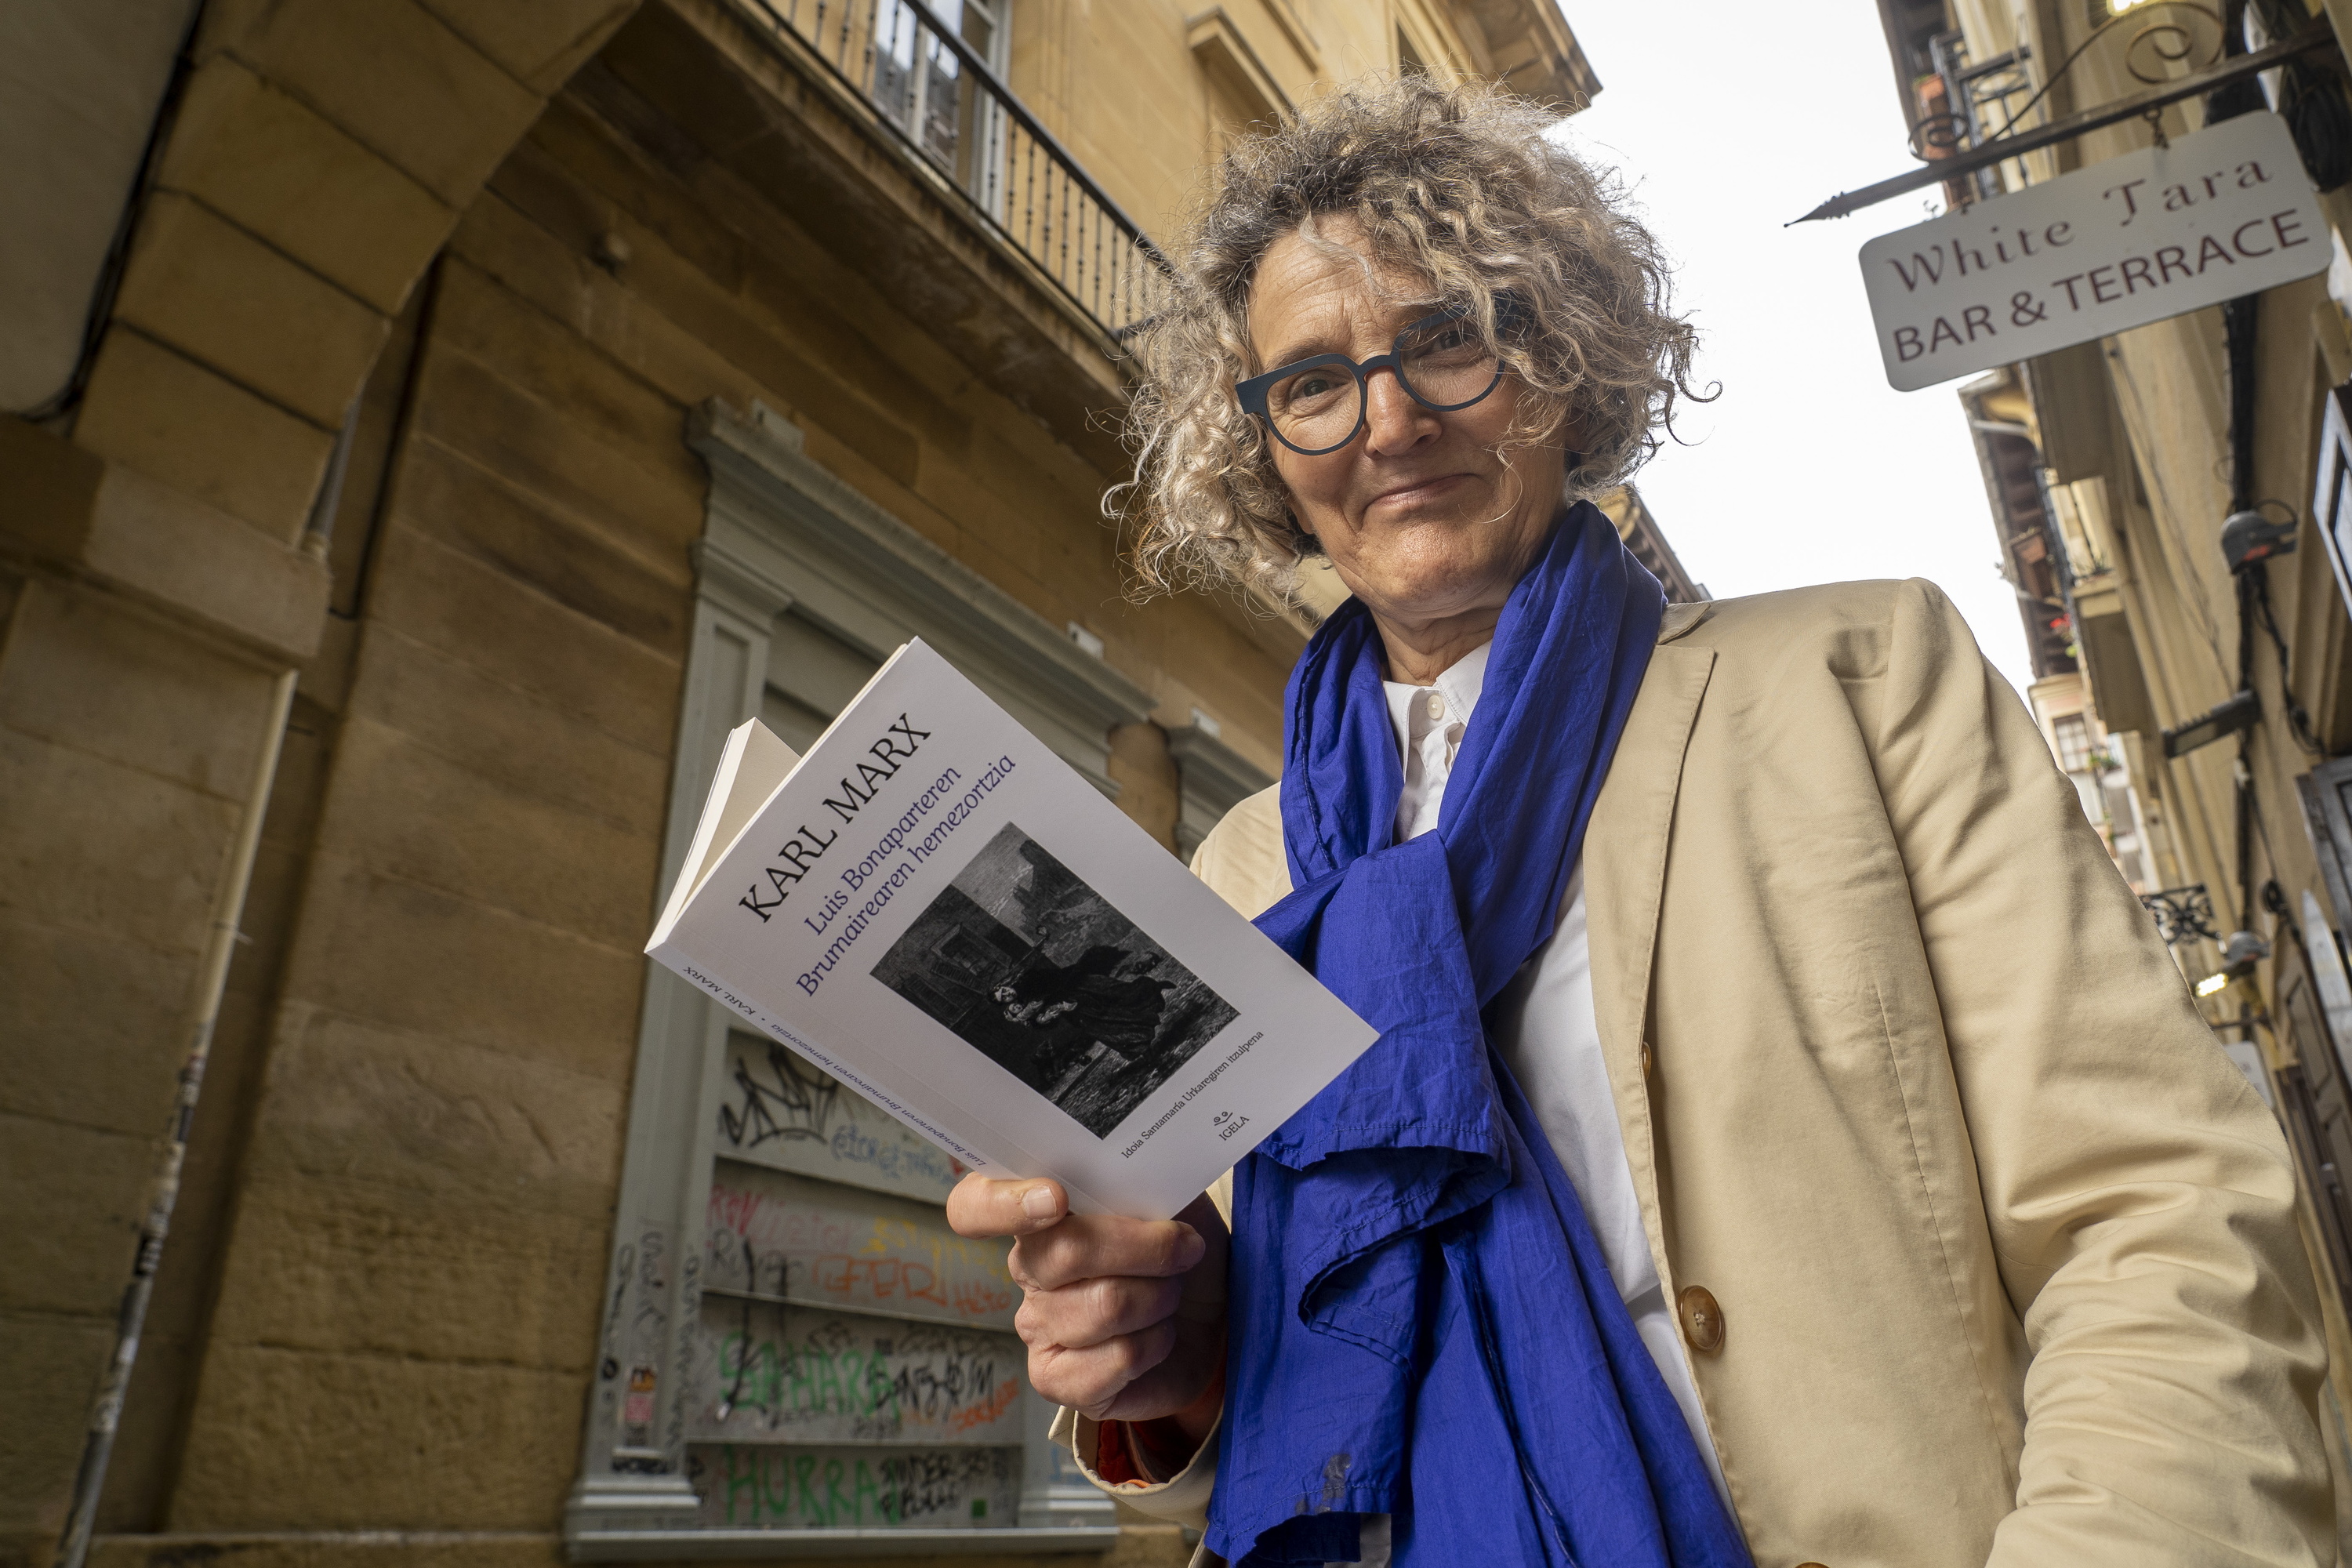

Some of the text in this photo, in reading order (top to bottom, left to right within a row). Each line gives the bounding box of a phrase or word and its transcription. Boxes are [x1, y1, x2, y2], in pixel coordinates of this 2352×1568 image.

[1887, 159, 2272, 292] White Tara
[1892, 208, 2310, 363] BAR & TERRACE
[739, 825, 838, 924] KARL
[822, 713, 931, 825] MARX
[804, 768, 961, 936] Luis Bonaparteren
[796, 862, 916, 997] Brumairearen
[906, 755, 1016, 864] hemezortzia
[683, 965, 724, 993] MARX
[724, 991, 757, 1016] KARL
[771, 1024, 833, 1065] hemezortzia
[833, 1065, 901, 1110] Brumairearen
[1121, 1031, 1264, 1159] Idoia Santamaría Urkaregiren itzulpena
[901, 1109, 966, 1152] Bonaparteren
[1218, 1116, 1250, 1142] IGELA
[964, 1152, 987, 1166] Luis
